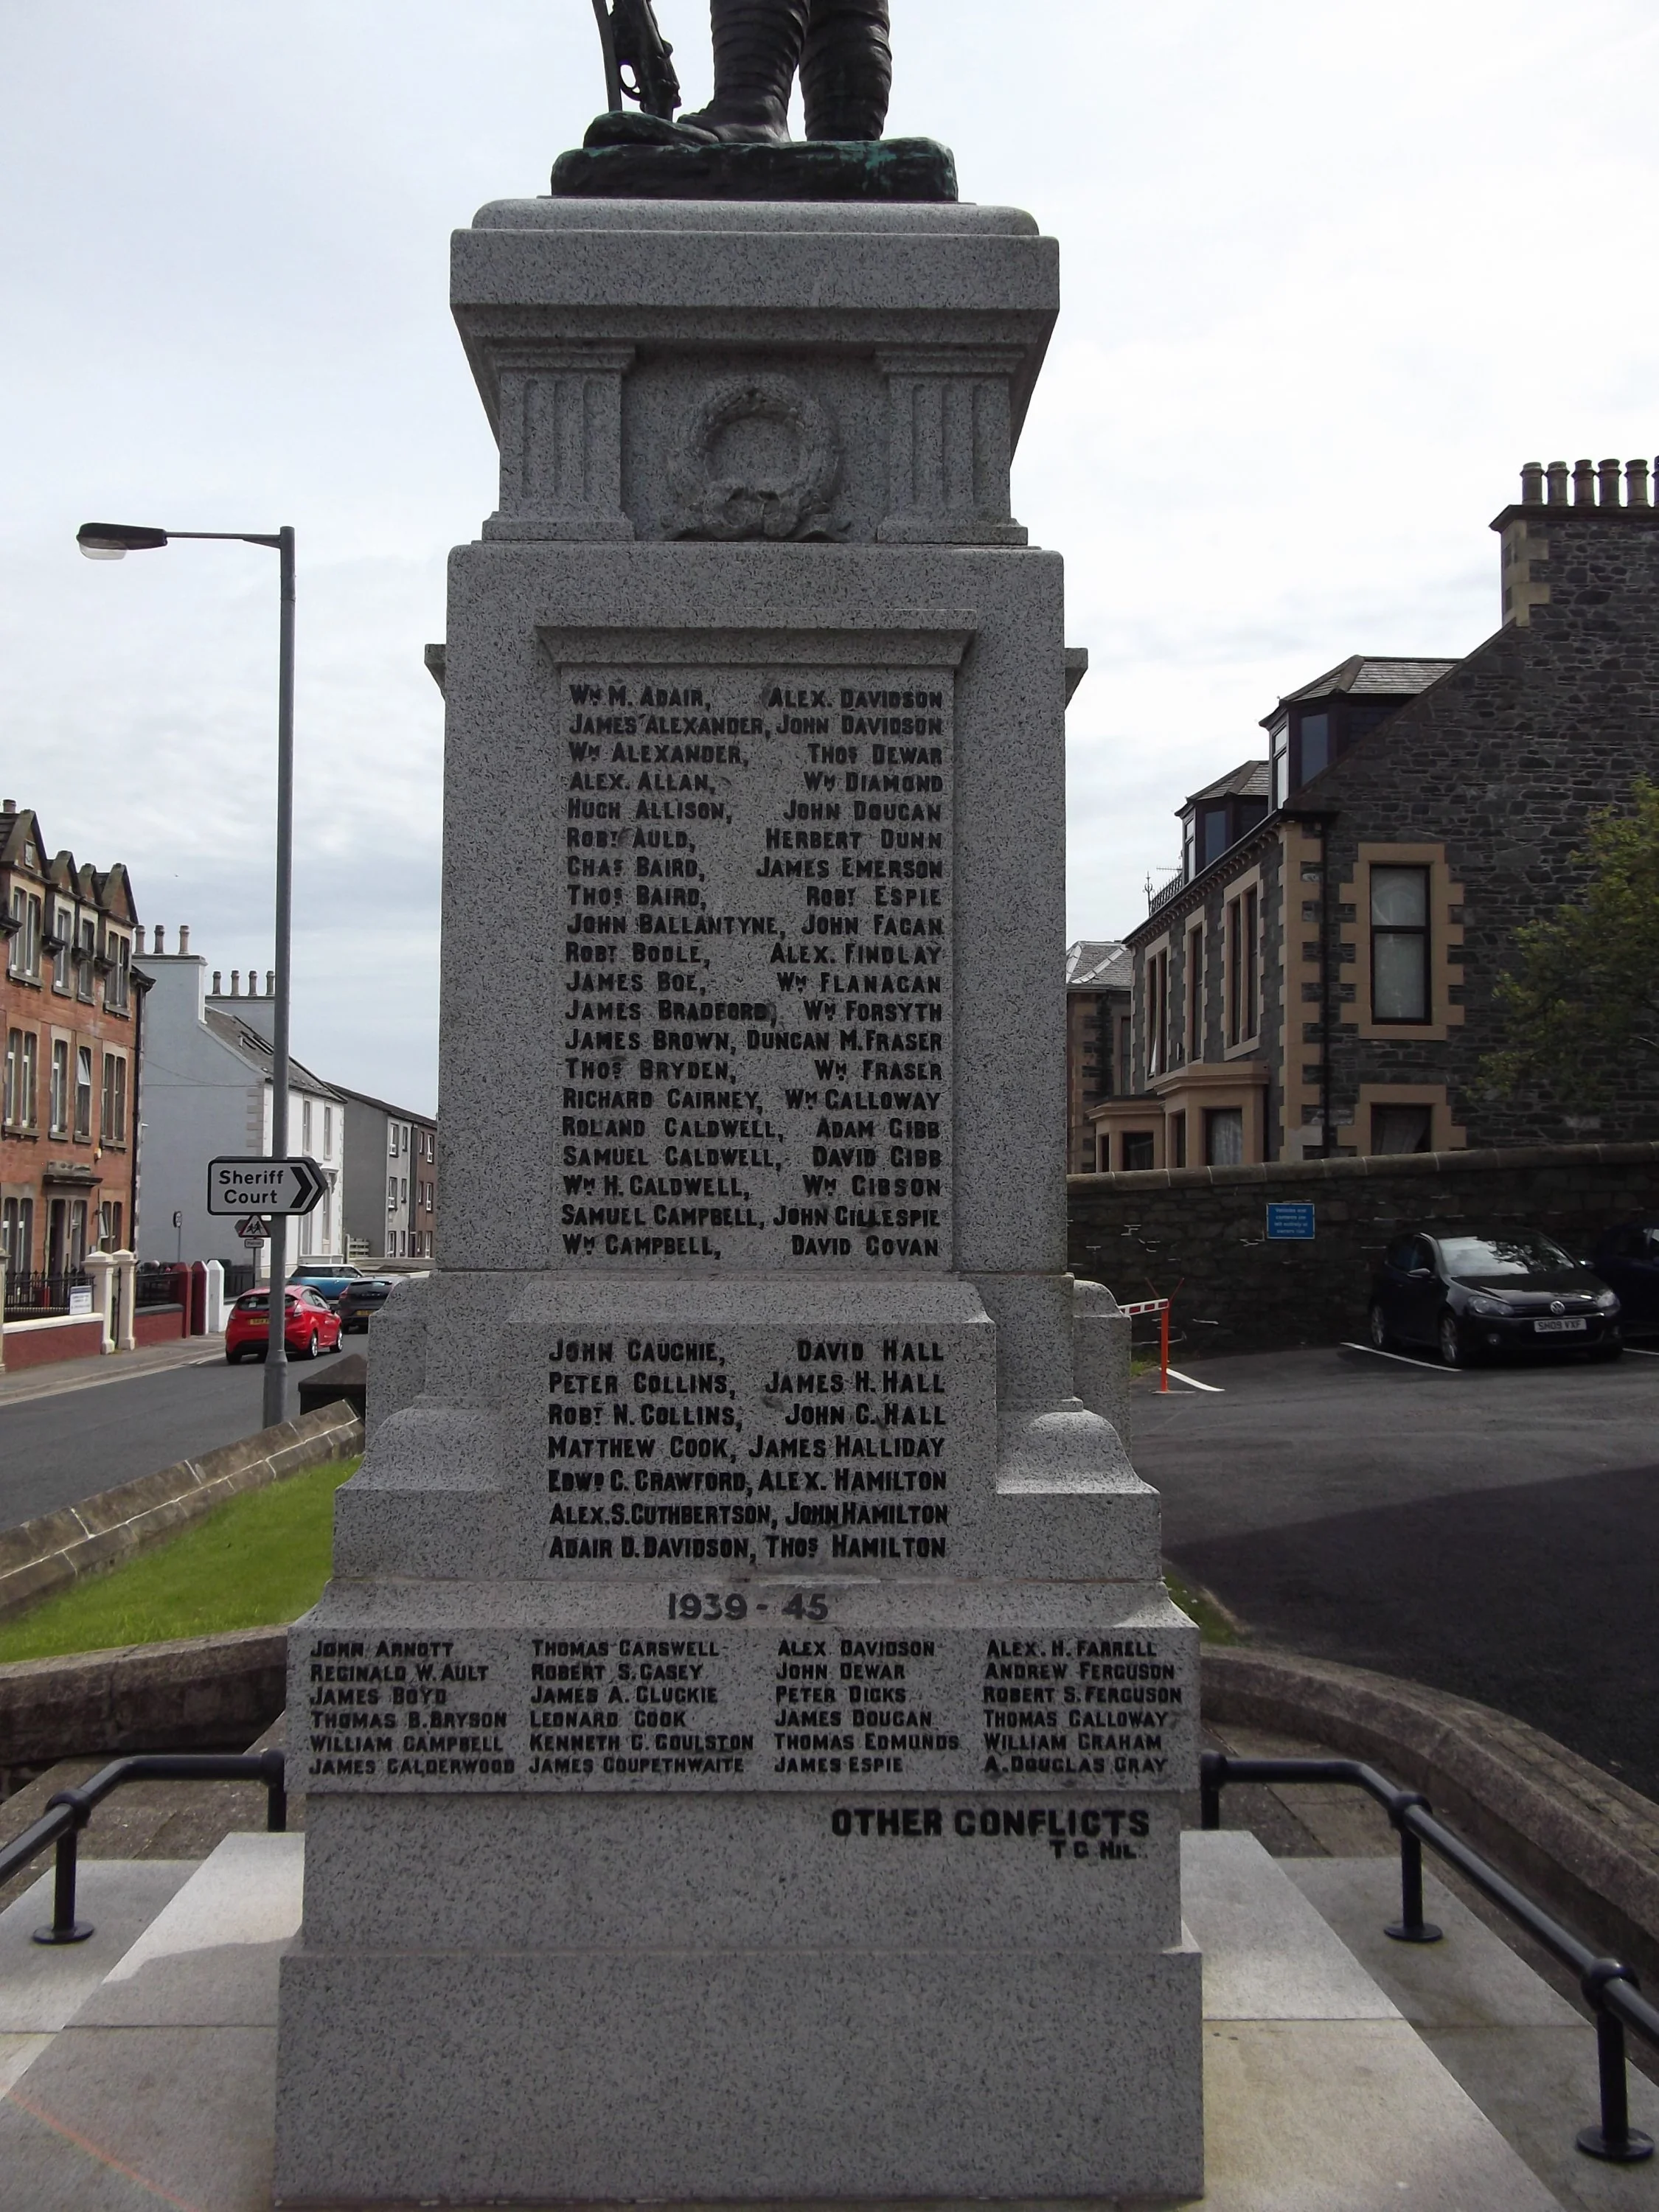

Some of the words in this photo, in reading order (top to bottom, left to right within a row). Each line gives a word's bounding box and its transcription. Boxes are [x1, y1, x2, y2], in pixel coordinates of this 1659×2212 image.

[768, 687, 832, 708] ALEX.
[840, 689, 942, 709] DAVIDSON
[569, 714, 636, 735] JAMES
[776, 714, 829, 734] JOHN
[842, 715, 942, 735] DAVIDSON
[873, 744, 942, 766] DEWAR
[570, 771, 629, 791] ALEX.
[784, 800, 841, 821] JOHN
[766, 828, 862, 849] HERBERT
[881, 829, 942, 849] DUNN
[757, 857, 829, 878] JAMES
[843, 858, 942, 879] EMERSON
[875, 886, 941, 907] ESPIE
[567, 914, 627, 934] JOHN
[801, 914, 858, 935] JOHN
[771, 942, 835, 964] ALEX.
[846, 943, 941, 964] FINDLAY
[566, 970, 643, 992] JAMES
[566, 1000, 641, 1020] JAMES
[566, 1029, 640, 1050] JAMES
[563, 1088, 653, 1109] RICHARD
[563, 1116, 644, 1137] ROLAND
[816, 1117, 874, 1140] ADAM
[563, 1146, 648, 1166] SAMUEL
[813, 1146, 876, 1167] DAVID
[218, 1169, 284, 1185] Sheriff
[224, 1189, 278, 1204] Court
[562, 1204, 646, 1226] SAMUEL
[773, 1206, 828, 1226] JOHN
[792, 1235, 851, 1255] DAVID
[549, 1339, 613, 1363] JOHN
[797, 1340, 863, 1362] DAVID
[883, 1339, 944, 1362] HALL
[549, 1371, 617, 1394] PETER
[765, 1371, 844, 1394] JAMES
[855, 1371, 877, 1392] H.
[883, 1371, 945, 1394] HALL
[613, 1404, 635, 1425] N.
[785, 1404, 844, 1425] JOHN
[856, 1403, 879, 1425] C.
[884, 1403, 946, 1426] HALL
[549, 1436, 655, 1458] MATTHEW
[749, 1435, 826, 1458] JAMES
[835, 1435, 945, 1458] HALLIDAY
[611, 1470, 629, 1491] C.
[758, 1470, 827, 1492] ALEX.
[835, 1468, 946, 1491] HAMILTON
[785, 1502, 838, 1524] JOHN
[842, 1502, 947, 1524] HAMILTON
[832, 1534, 945, 1558] HAMILTON
[669, 1593, 747, 1621] 1939
[782, 1593, 828, 1621] 45
[310, 1641, 364, 1658] JOHN
[375, 1641, 453, 1658] ARNOTT
[532, 1639, 608, 1658] THOMAS
[620, 1640, 719, 1656] CARSWELL
[841, 1639, 934, 1657] DAVIDSON
[987, 1640, 1046, 1659] ALEX.
[1052, 1640, 1071, 1657] H.
[1077, 1640, 1156, 1658] FARRELL
[776, 1662, 827, 1680] JOHN
[841, 1663, 905, 1680] DEWAR
[986, 1663, 1067, 1680] ANDREW
[310, 1686, 380, 1705] JAMES
[393, 1686, 446, 1705] BOYD
[531, 1686, 598, 1704] JAMES
[608, 1686, 629, 1703] A.
[636, 1685, 717, 1704] CLUCKIE
[776, 1686, 835, 1705] PETER
[849, 1686, 905, 1704] DICKS
[530, 1711, 618, 1728] LEONARD
[635, 1710, 686, 1728] COOK
[775, 1709, 841, 1727] JAMES
[984, 1709, 1057, 1728] THOMAS
[310, 1736, 392, 1752] WILLIAM
[403, 1736, 503, 1753] CAMPBELL
[530, 1734, 619, 1752] KENNETH
[631, 1733, 650, 1750] C.
[655, 1734, 753, 1752] COULSTON
[774, 1733, 854, 1750] THOMAS
[866, 1733, 959, 1750] EDMUNDS
[984, 1733, 1066, 1754] WILLIAM
[309, 1759, 375, 1775] JAMES
[388, 1759, 514, 1777] CALDERWOOD
[529, 1756, 593, 1775] JAMES
[775, 1756, 841, 1773] JAMES
[849, 1756, 902, 1773] ESPIE
[832, 1808, 942, 1836] OTHER
[955, 1809, 1149, 1837] CONFLICTS
